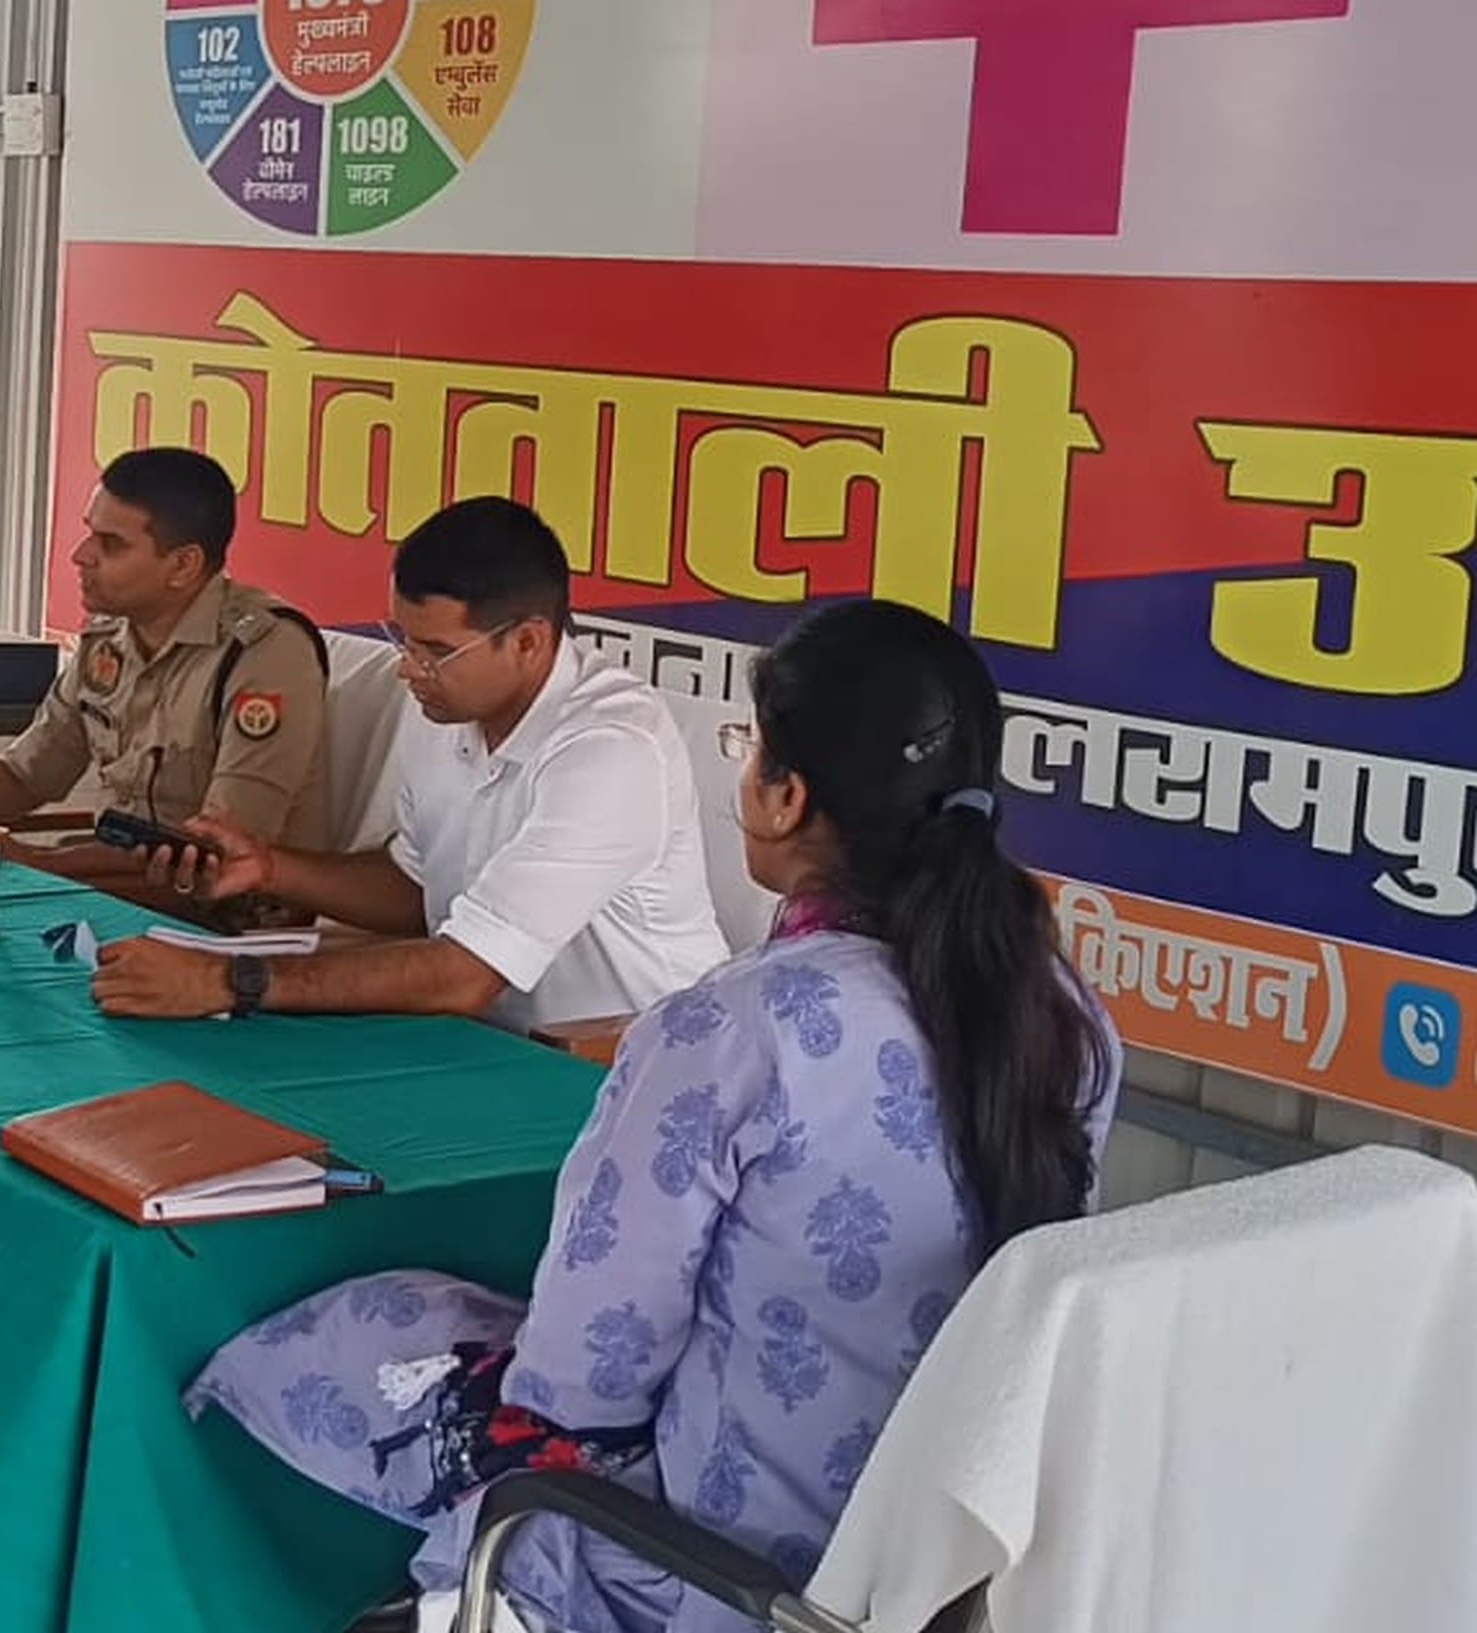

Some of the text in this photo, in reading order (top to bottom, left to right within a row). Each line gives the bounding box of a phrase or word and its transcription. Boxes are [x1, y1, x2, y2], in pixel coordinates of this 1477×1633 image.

[198, 26, 241, 62] 102
[440, 15, 497, 56] 108
[289, 47, 372, 76] हेल्पलाइन
[445, 92, 481, 118] सेवा
[259, 118, 302, 153] 181
[337, 115, 409, 154] 1098
[86, 289, 1477, 693] कोतवाली उ
[999, 692, 1477, 917] लरामपु
[1053, 882, 1347, 1071] किएशन)
